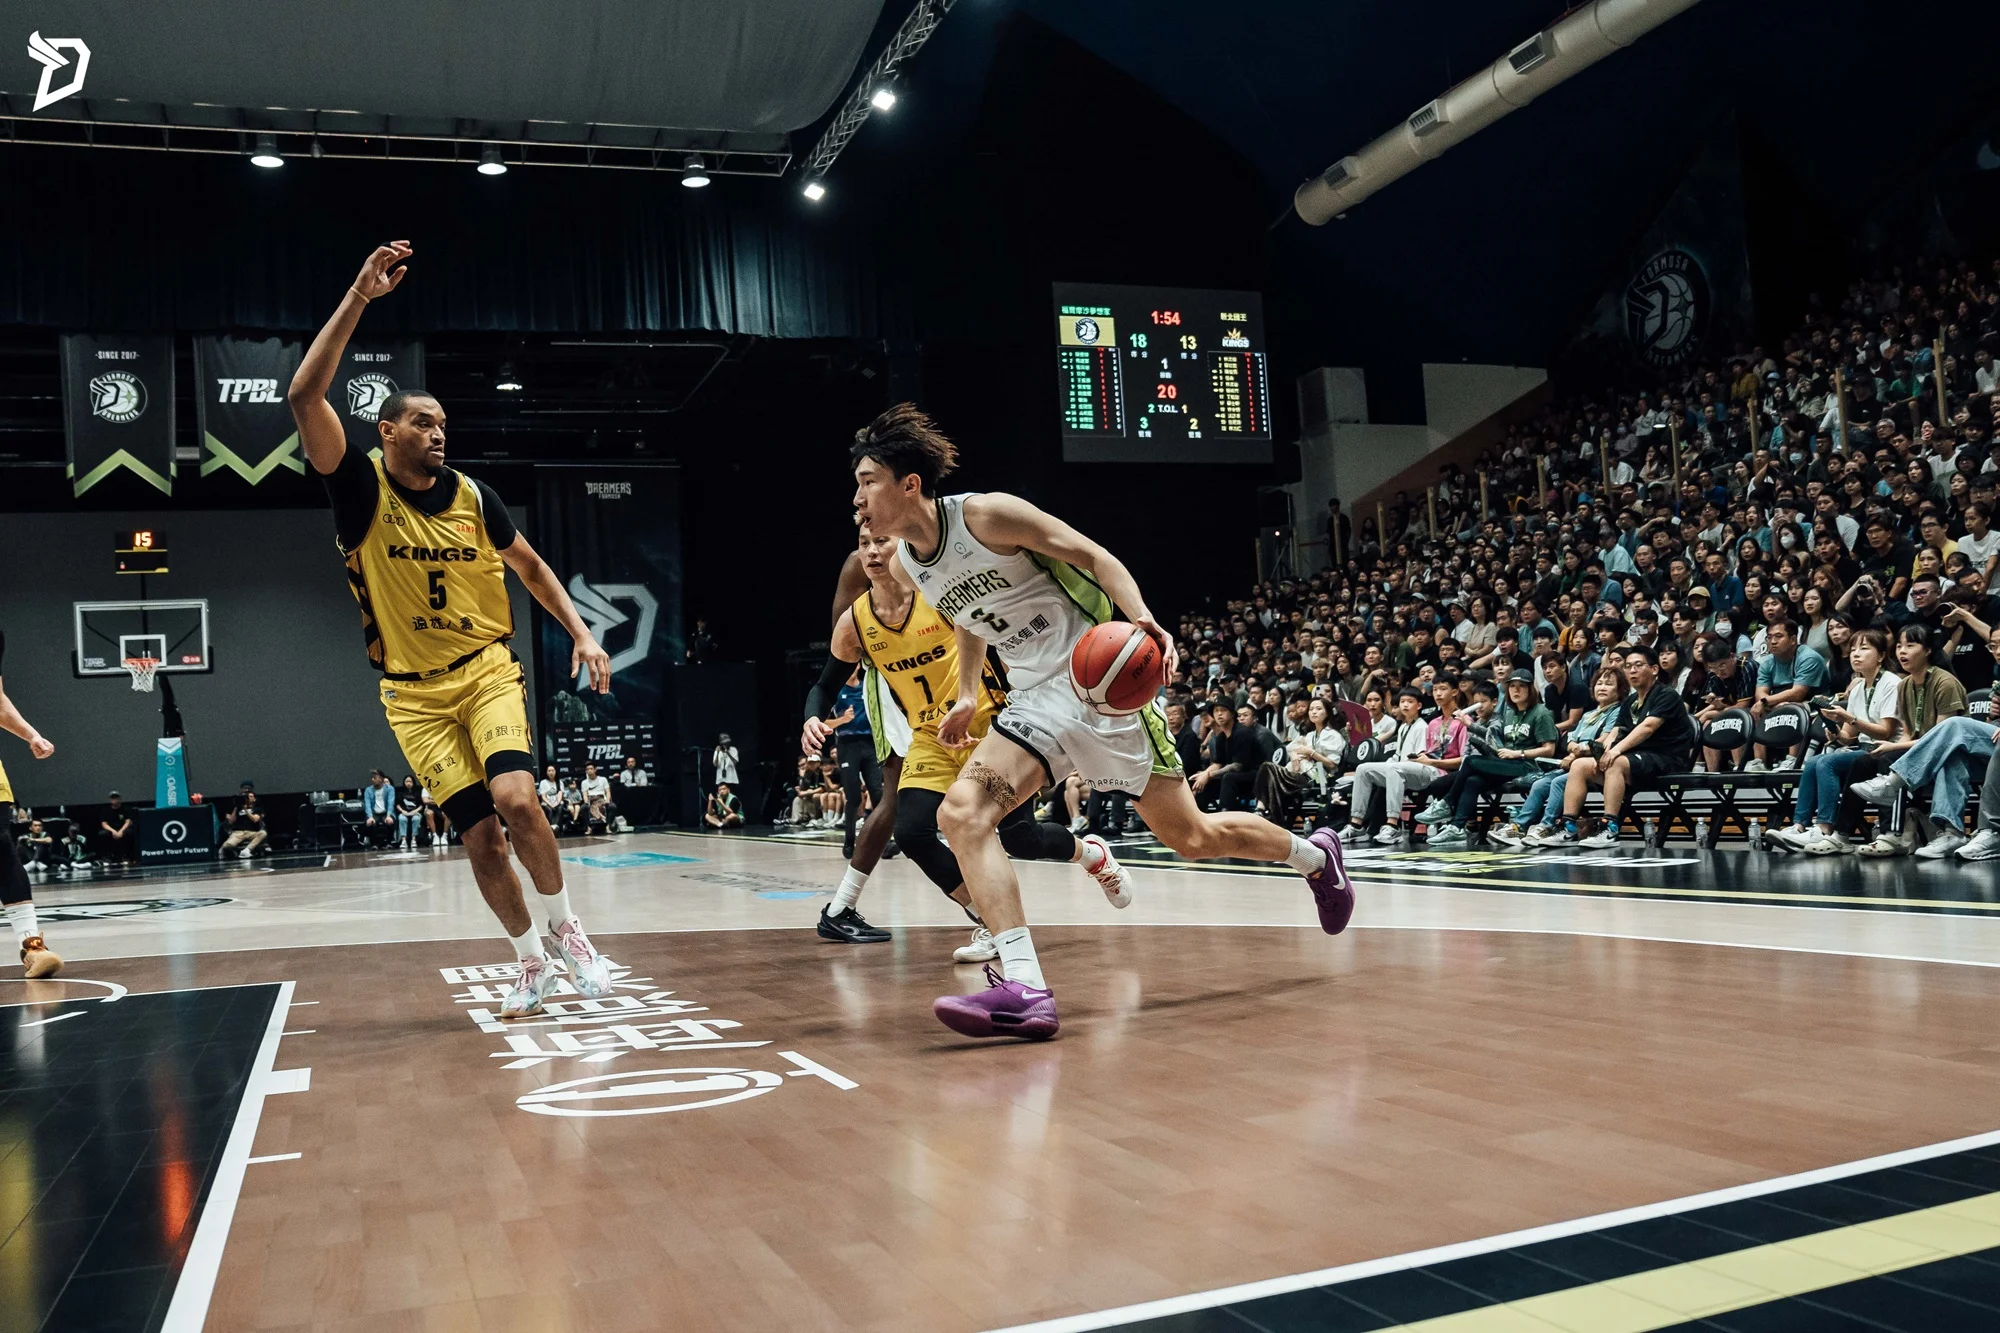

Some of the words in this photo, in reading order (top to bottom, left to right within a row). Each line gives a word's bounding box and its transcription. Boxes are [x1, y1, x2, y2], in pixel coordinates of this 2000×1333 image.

[1151, 311, 1181, 325] 1:54
[1130, 333, 1148, 348] 18
[1180, 335, 1197, 350] 13
[1222, 338, 1249, 348] KINGS
[1161, 358, 1168, 369] 1
[217, 378, 283, 403] TPBL
[1157, 384, 1177, 399] 20
[1148, 403, 1156, 413] 2
[1181, 404, 1188, 414] 1
[1140, 417, 1149, 429] 3
[1190, 418, 1199, 430] 2
[585, 482, 632, 495] DREAMERS
[135, 532, 152, 547] 15
[388, 545, 477, 562] KINGS
[428, 570, 447, 611] 5
[917, 624, 940, 637] SAMPO
[883, 645, 946, 673] KINGS
[587, 744, 625, 760] TPBL
[142, 849, 164, 857] Power
